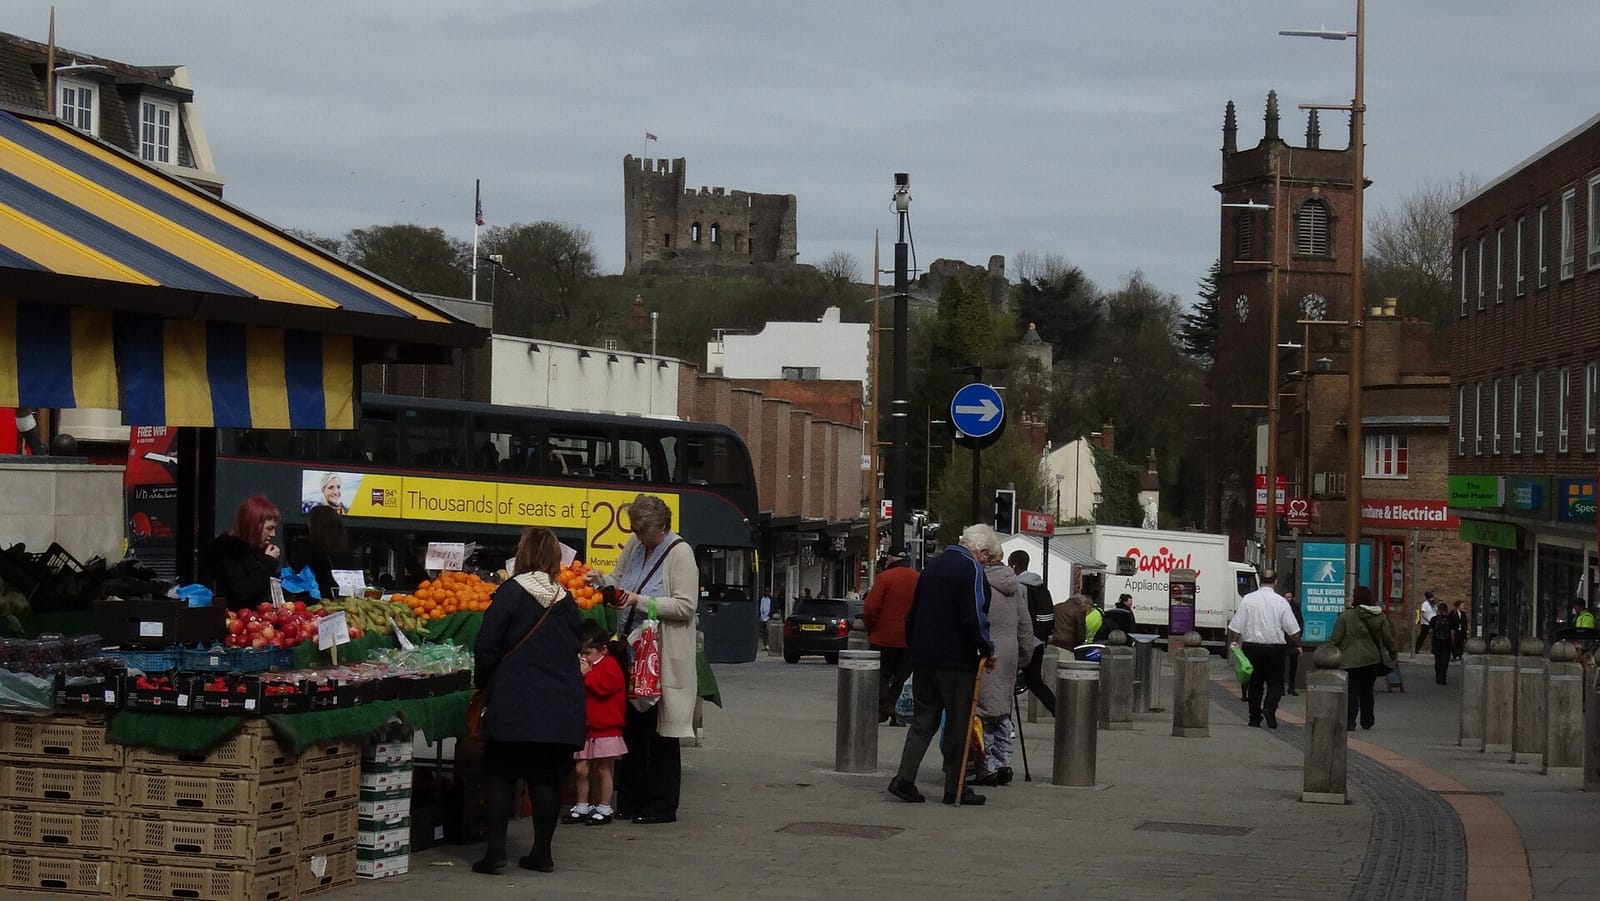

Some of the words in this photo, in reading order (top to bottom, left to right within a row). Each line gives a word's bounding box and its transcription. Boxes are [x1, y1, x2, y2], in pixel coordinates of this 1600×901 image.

[137, 426, 153, 437] FREE
[408, 490, 493, 513] Thousands
[498, 496, 513, 515] of
[518, 500, 556, 518] seats
[561, 501, 575, 519] at
[1384, 505, 1391, 519] &
[1392, 505, 1448, 521] Electrical
[1126, 547, 1200, 578] Capital
[1124, 578, 1169, 592] Appliance
[1307, 596, 1323, 604] TURN
[1323, 596, 1329, 604] A
[1307, 604, 1324, 612] WALK
